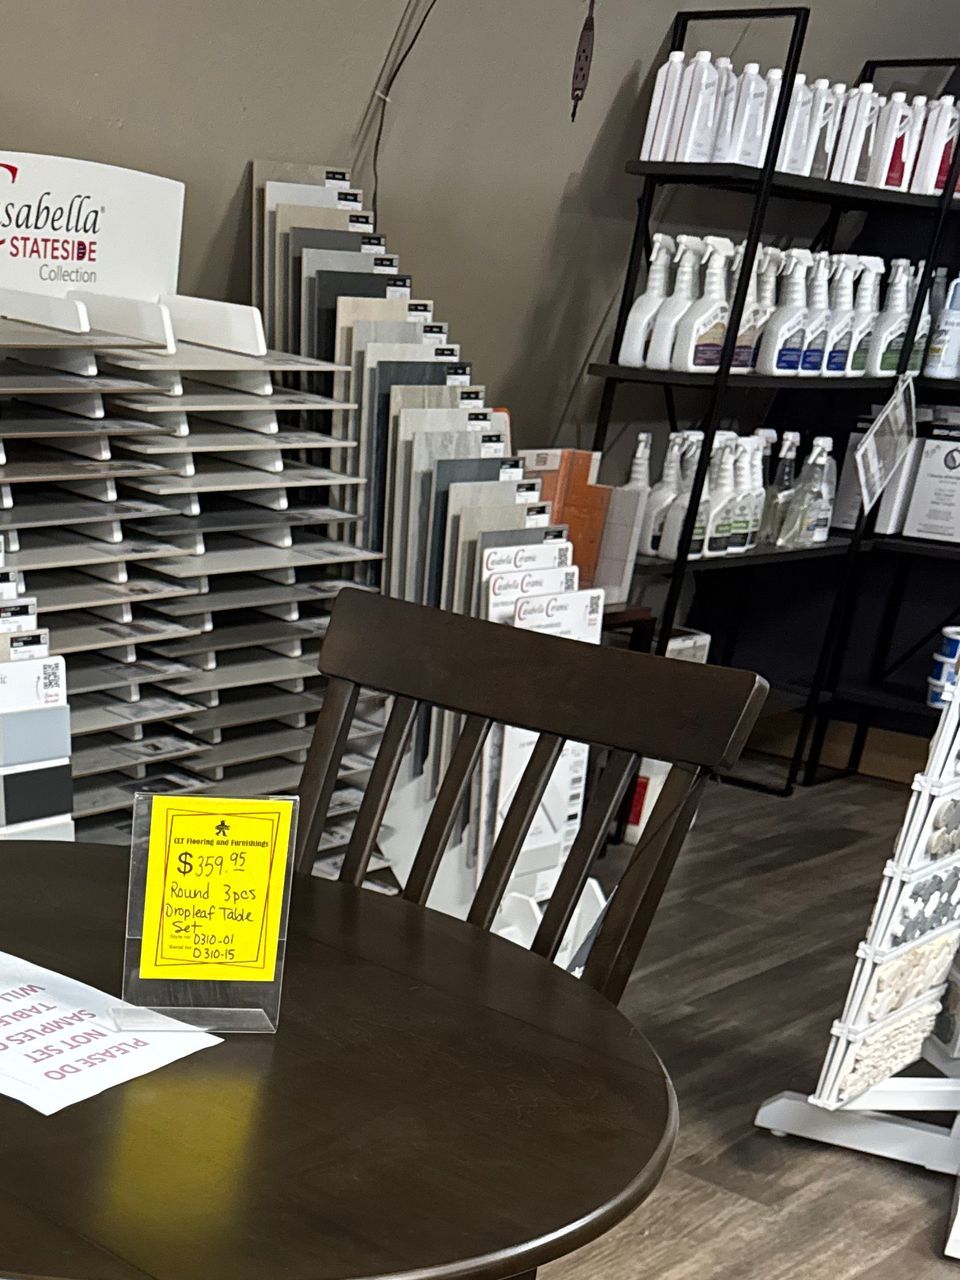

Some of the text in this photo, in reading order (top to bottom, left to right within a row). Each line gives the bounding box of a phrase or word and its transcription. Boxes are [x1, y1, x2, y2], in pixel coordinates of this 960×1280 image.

[10, 236, 96, 262] STATESIDE
[40, 264, 96, 282] Collection
[186, 838, 214, 846] Flooring
[230, 840, 269, 848] Furnishings
[170, 881, 256, 904] Round 3pcs
[166, 903, 254, 922] Dropleaf Table
[172, 920, 203, 934] Set
[194, 934, 234, 946] D310-01
[5, 1009, 96, 1044] SAMPLES
[24, 1029, 108, 1064] NOT SET
[44, 1038, 150, 1080] PLEASE DO
